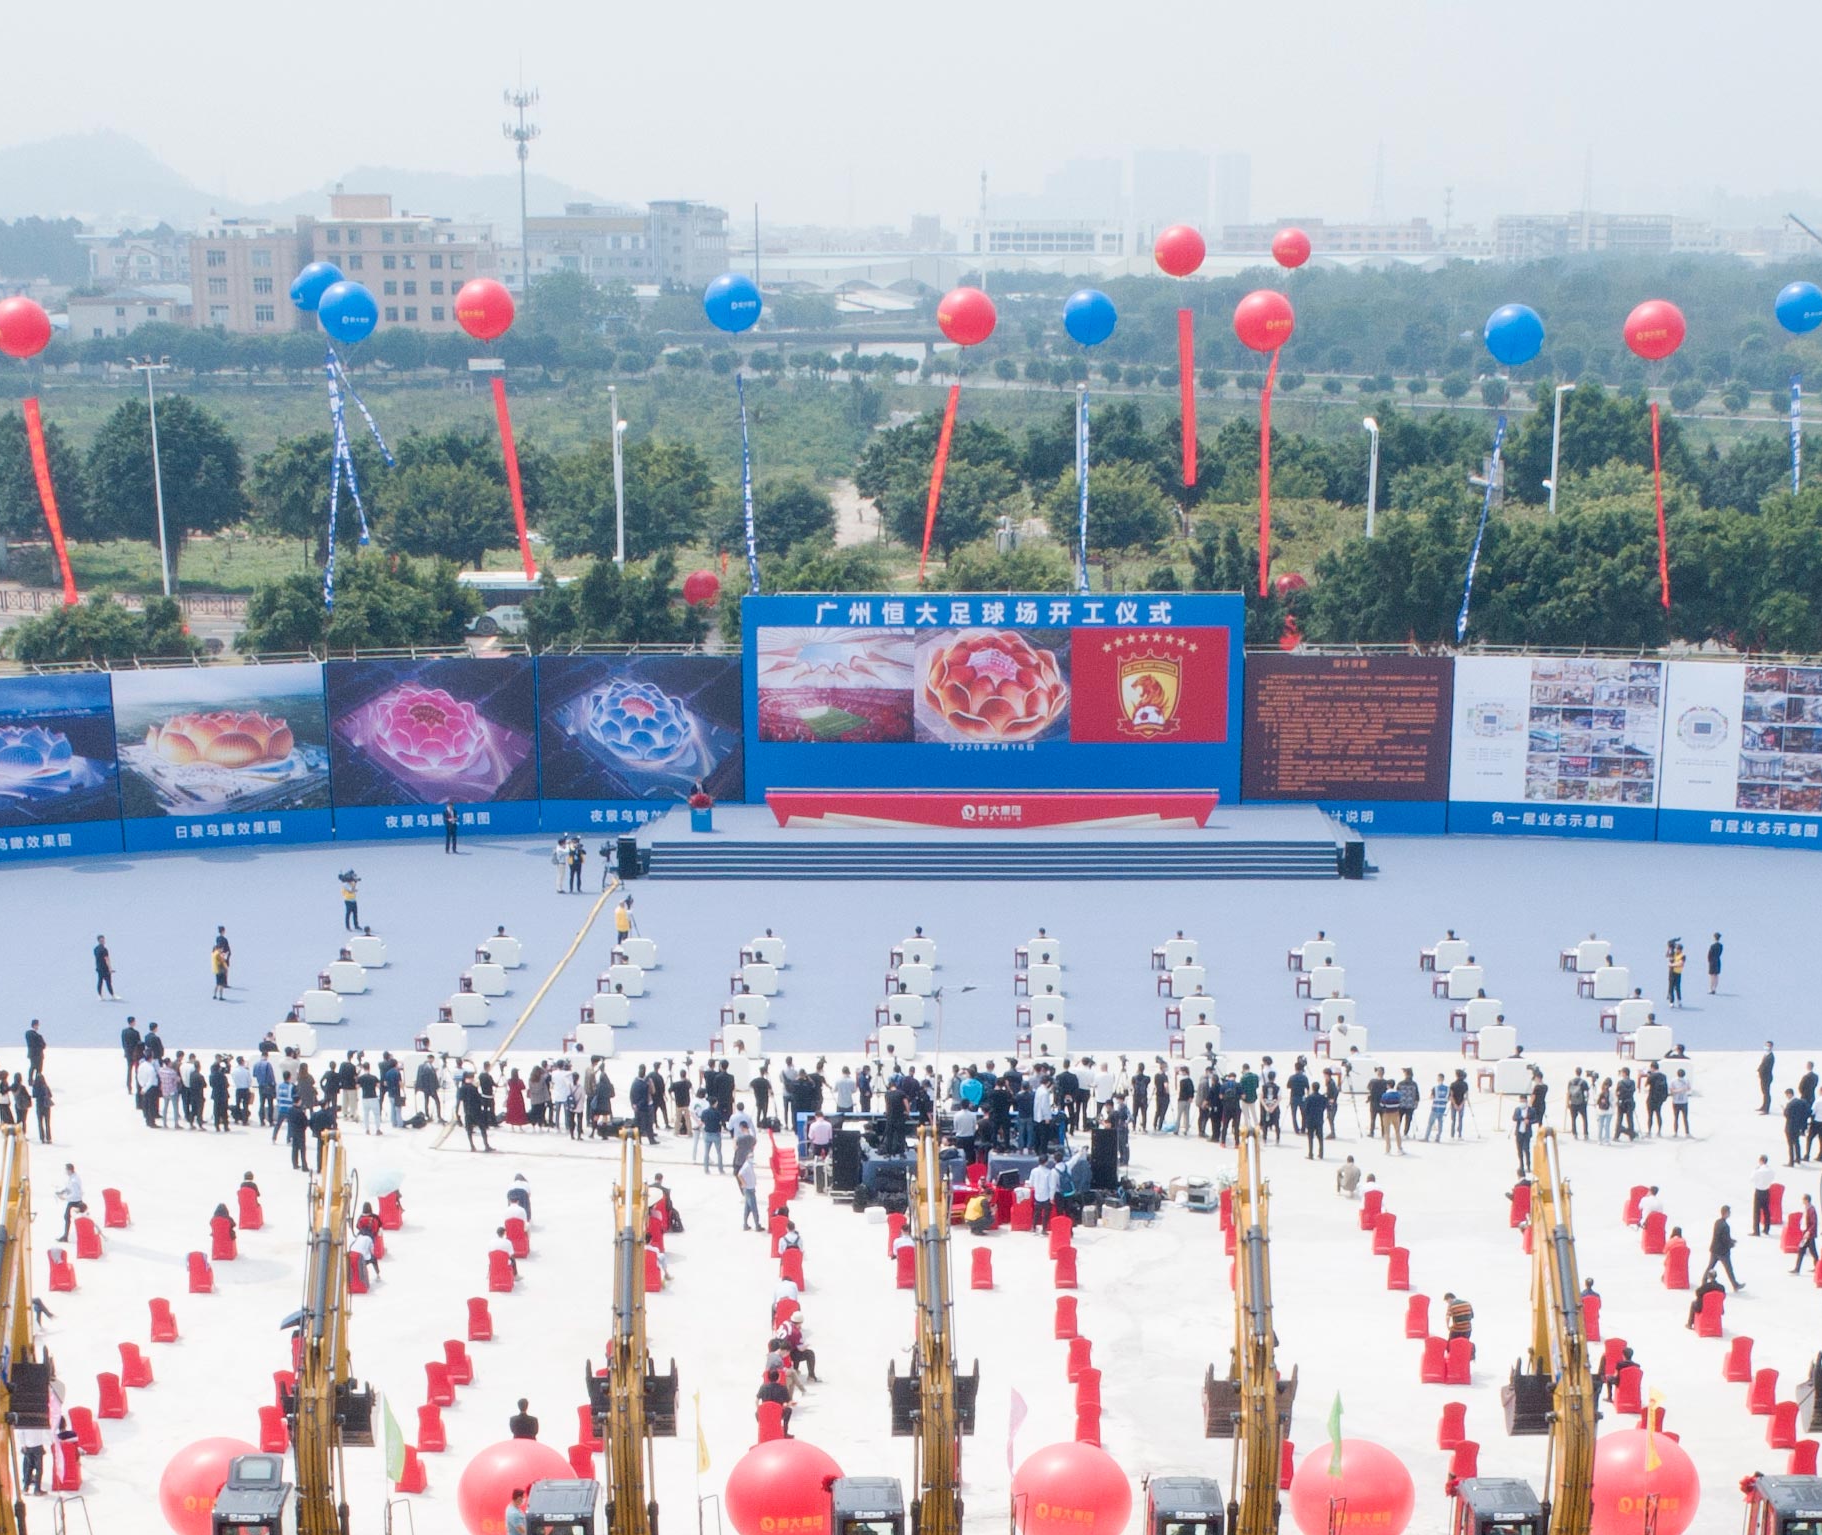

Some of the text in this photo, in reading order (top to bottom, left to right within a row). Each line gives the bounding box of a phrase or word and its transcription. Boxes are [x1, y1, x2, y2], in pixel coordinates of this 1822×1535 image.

[816, 601, 1175, 625] 广州恒大足球场开工仪式
[950, 743, 1035, 752] 2020年4月16日
[978, 805, 1022, 816] 恒大集团
[385, 811, 491, 829] 夜景鸟瞰果图
[1491, 811, 1615, 830] 负一层业态示意图
[1710, 818, 1819, 838] 首层业态示意图
[175, 820, 282, 839] 日景鸟瞰效果图
[778, 1515, 823, 1530] 恒大集团
